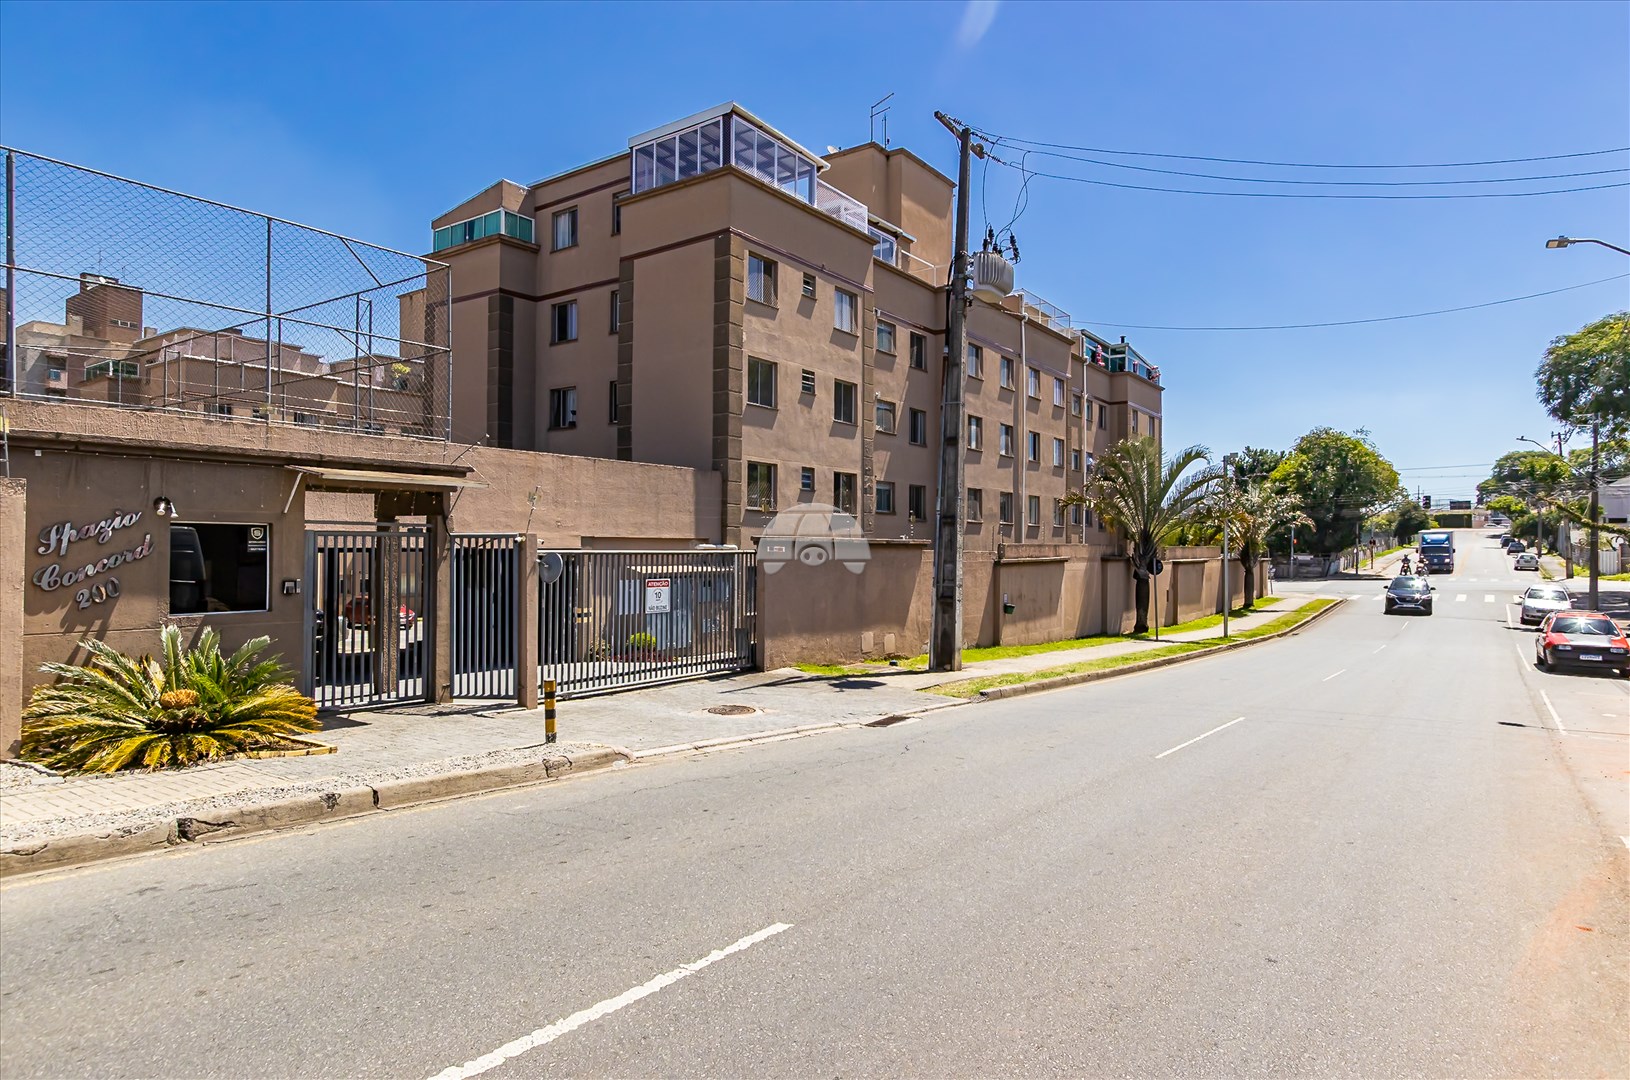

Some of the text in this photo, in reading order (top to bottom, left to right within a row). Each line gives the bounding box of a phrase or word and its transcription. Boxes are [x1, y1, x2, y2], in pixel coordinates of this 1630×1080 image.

[37, 511, 143, 556] Spazio
[32, 533, 155, 591] Concord
[76, 576, 120, 610] 200
